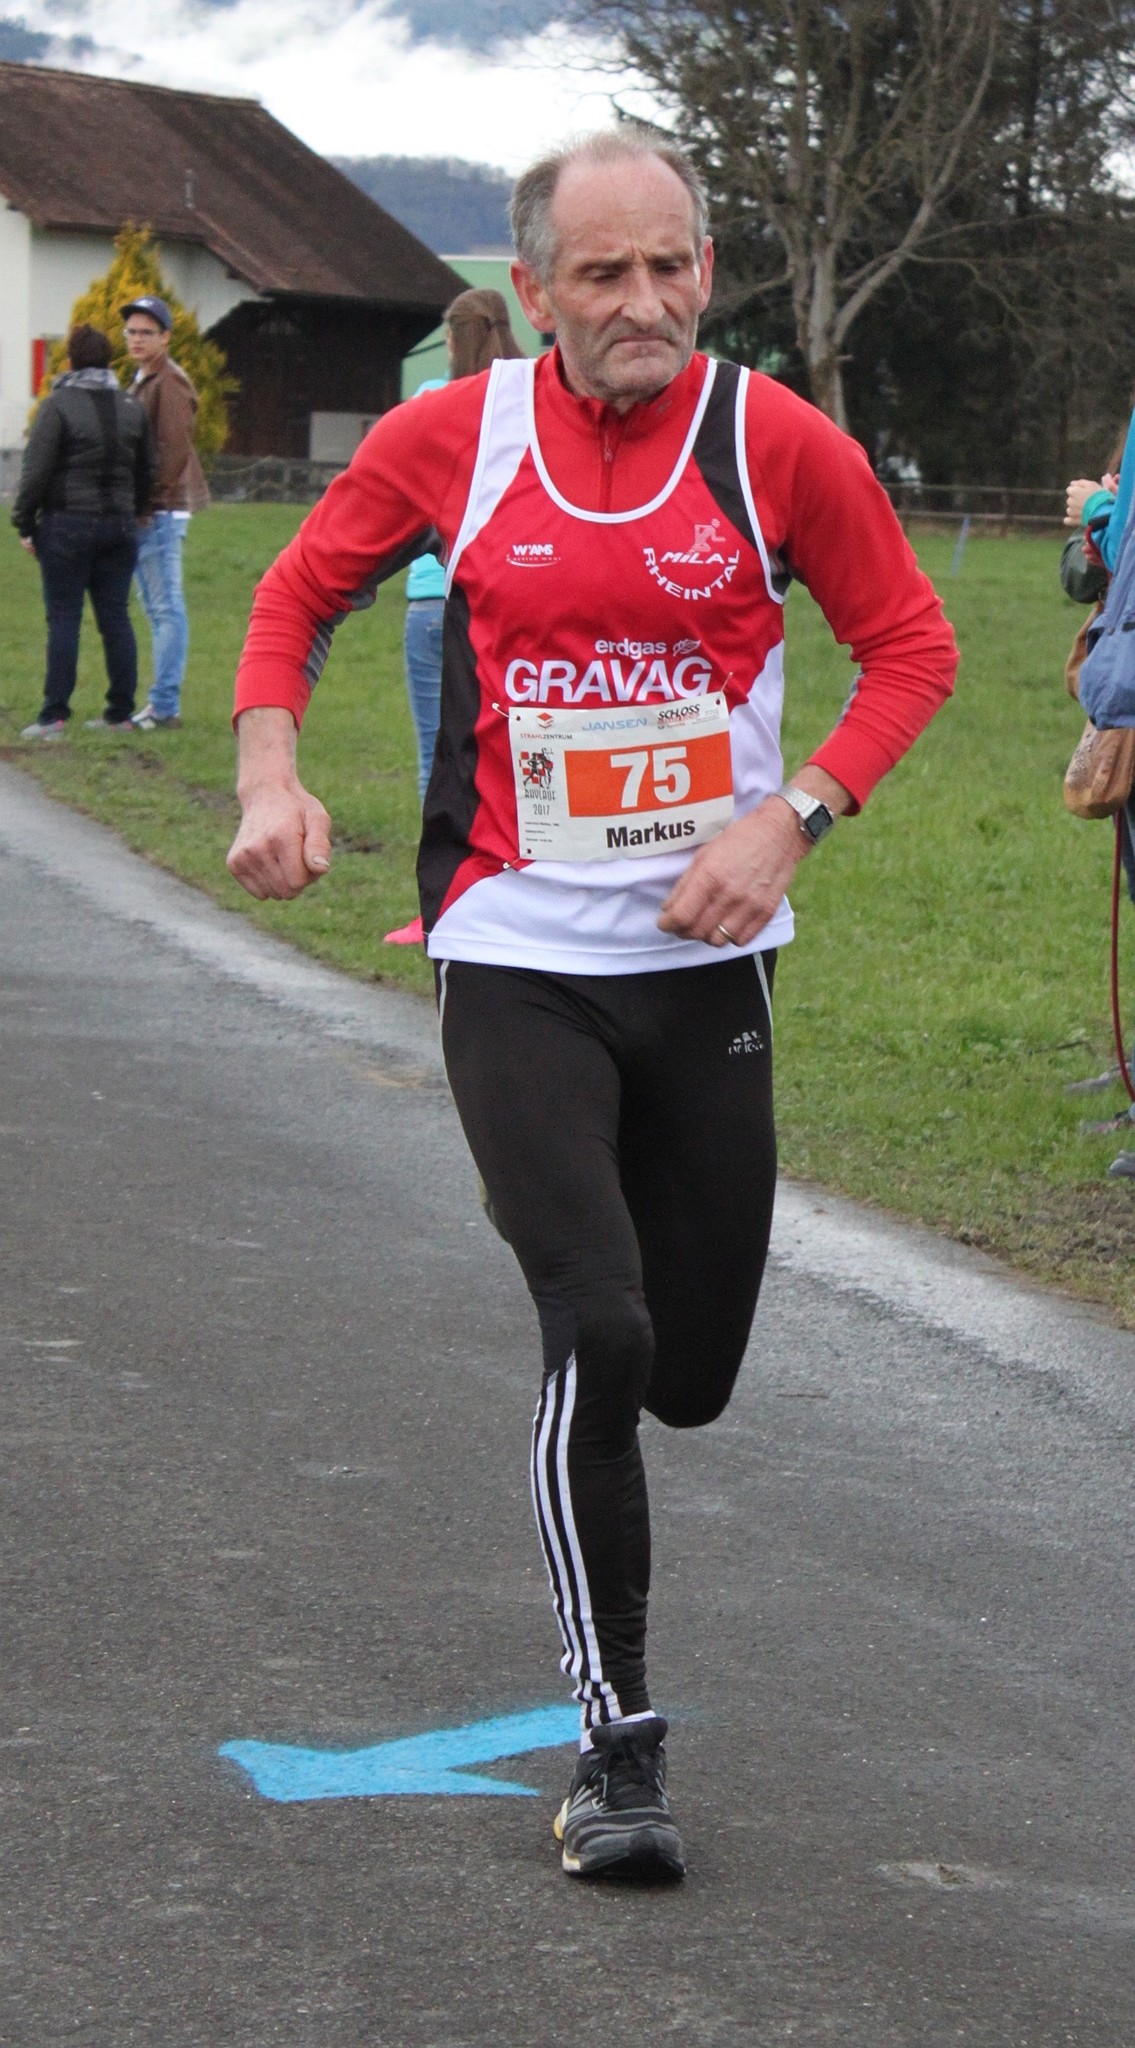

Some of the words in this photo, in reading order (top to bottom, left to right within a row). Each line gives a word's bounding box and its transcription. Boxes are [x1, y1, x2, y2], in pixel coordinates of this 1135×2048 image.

[643, 547, 740, 600] RHEINTAL
[595, 638, 667, 659] erdgas
[505, 656, 713, 703] GRAVAG
[582, 717, 648, 731] JANSEN
[657, 703, 701, 721] SCHLOSS
[610, 745, 691, 809] 75
[533, 803, 550, 816] 2017
[606, 820, 696, 848] Markus
